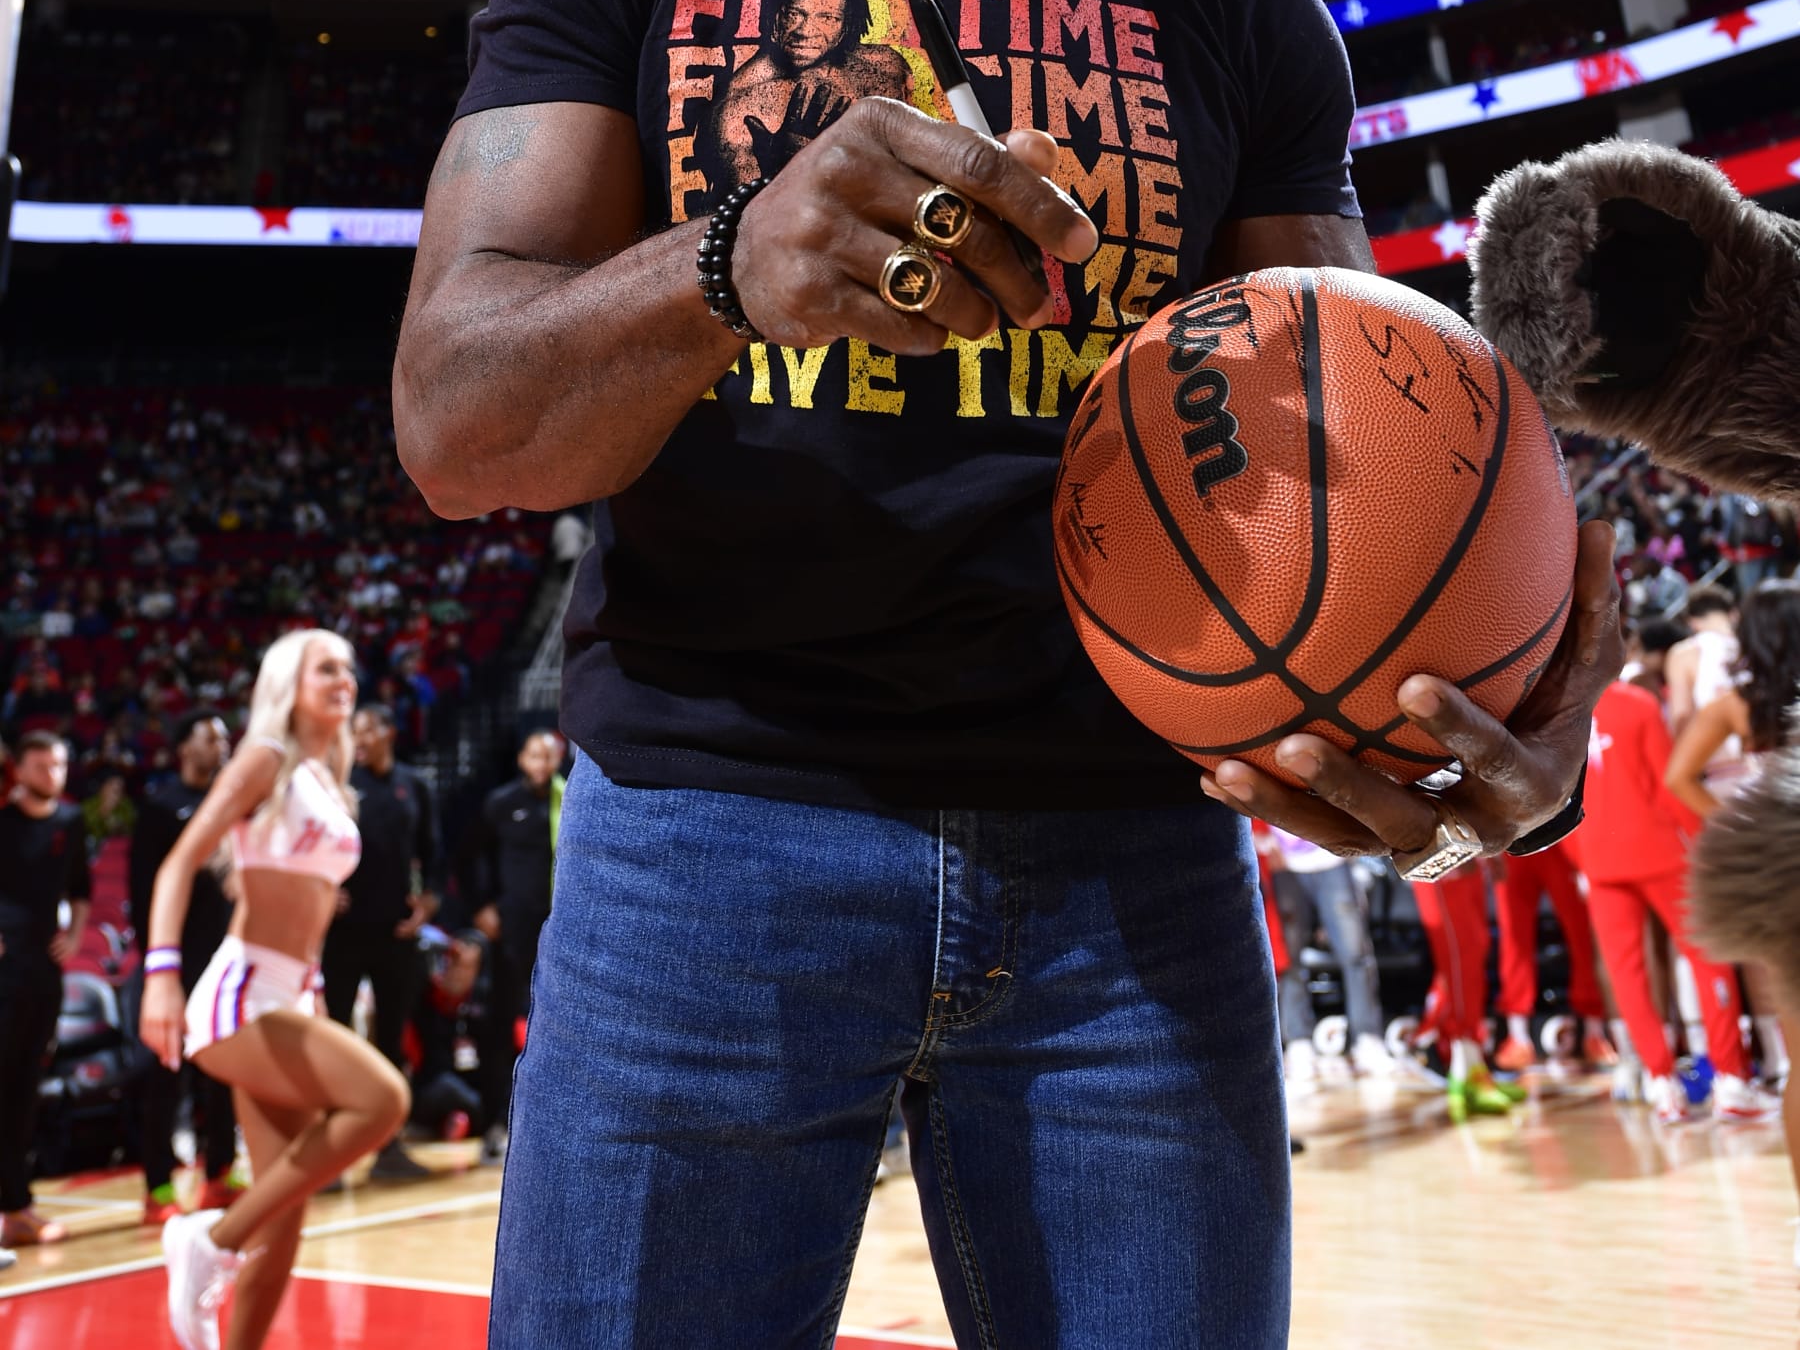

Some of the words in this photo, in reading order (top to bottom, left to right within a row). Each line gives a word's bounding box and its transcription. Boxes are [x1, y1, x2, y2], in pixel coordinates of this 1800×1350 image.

[964, 53, 1179, 162] IME
[702, 335, 906, 417] IVE
[943, 327, 1130, 418] TIM
